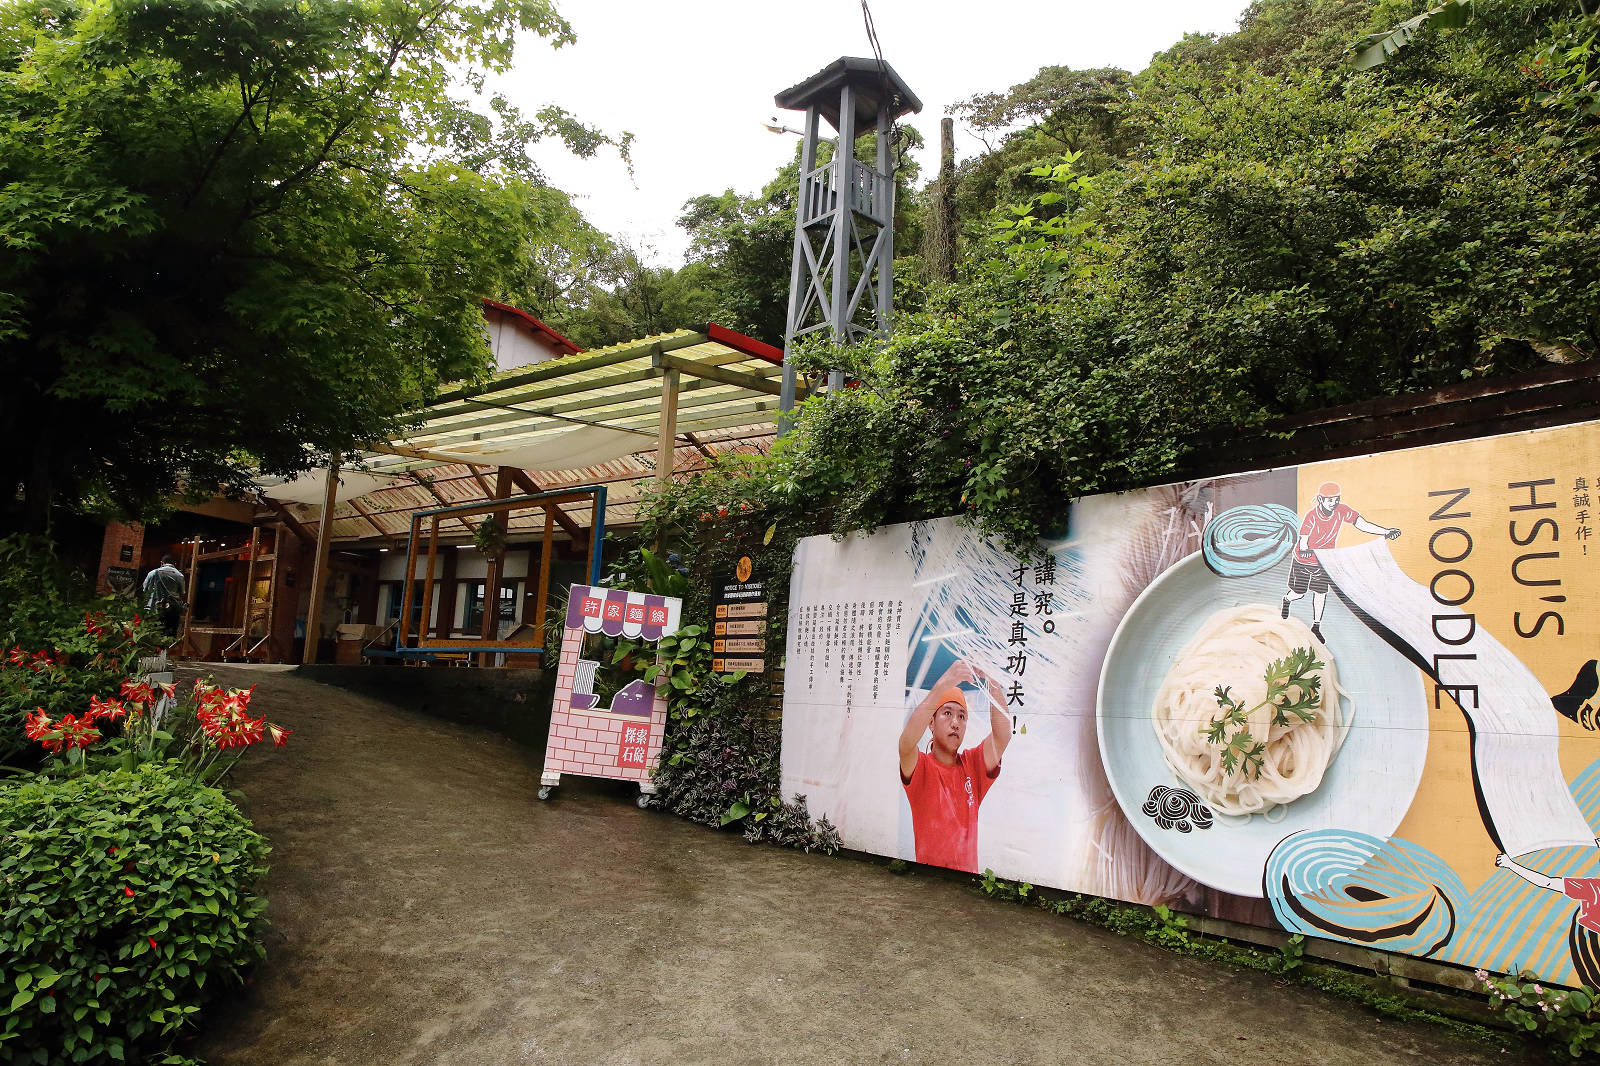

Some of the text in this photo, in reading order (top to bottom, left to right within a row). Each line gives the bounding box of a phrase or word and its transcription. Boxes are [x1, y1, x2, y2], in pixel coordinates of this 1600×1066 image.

[1507, 478, 1567, 639] HSU'S
[1428, 487, 1480, 710] NOODLE
[583, 599, 666, 624] 許家麵線
[624, 726, 648, 745] 探索
[622, 746, 645, 764] 石碇
